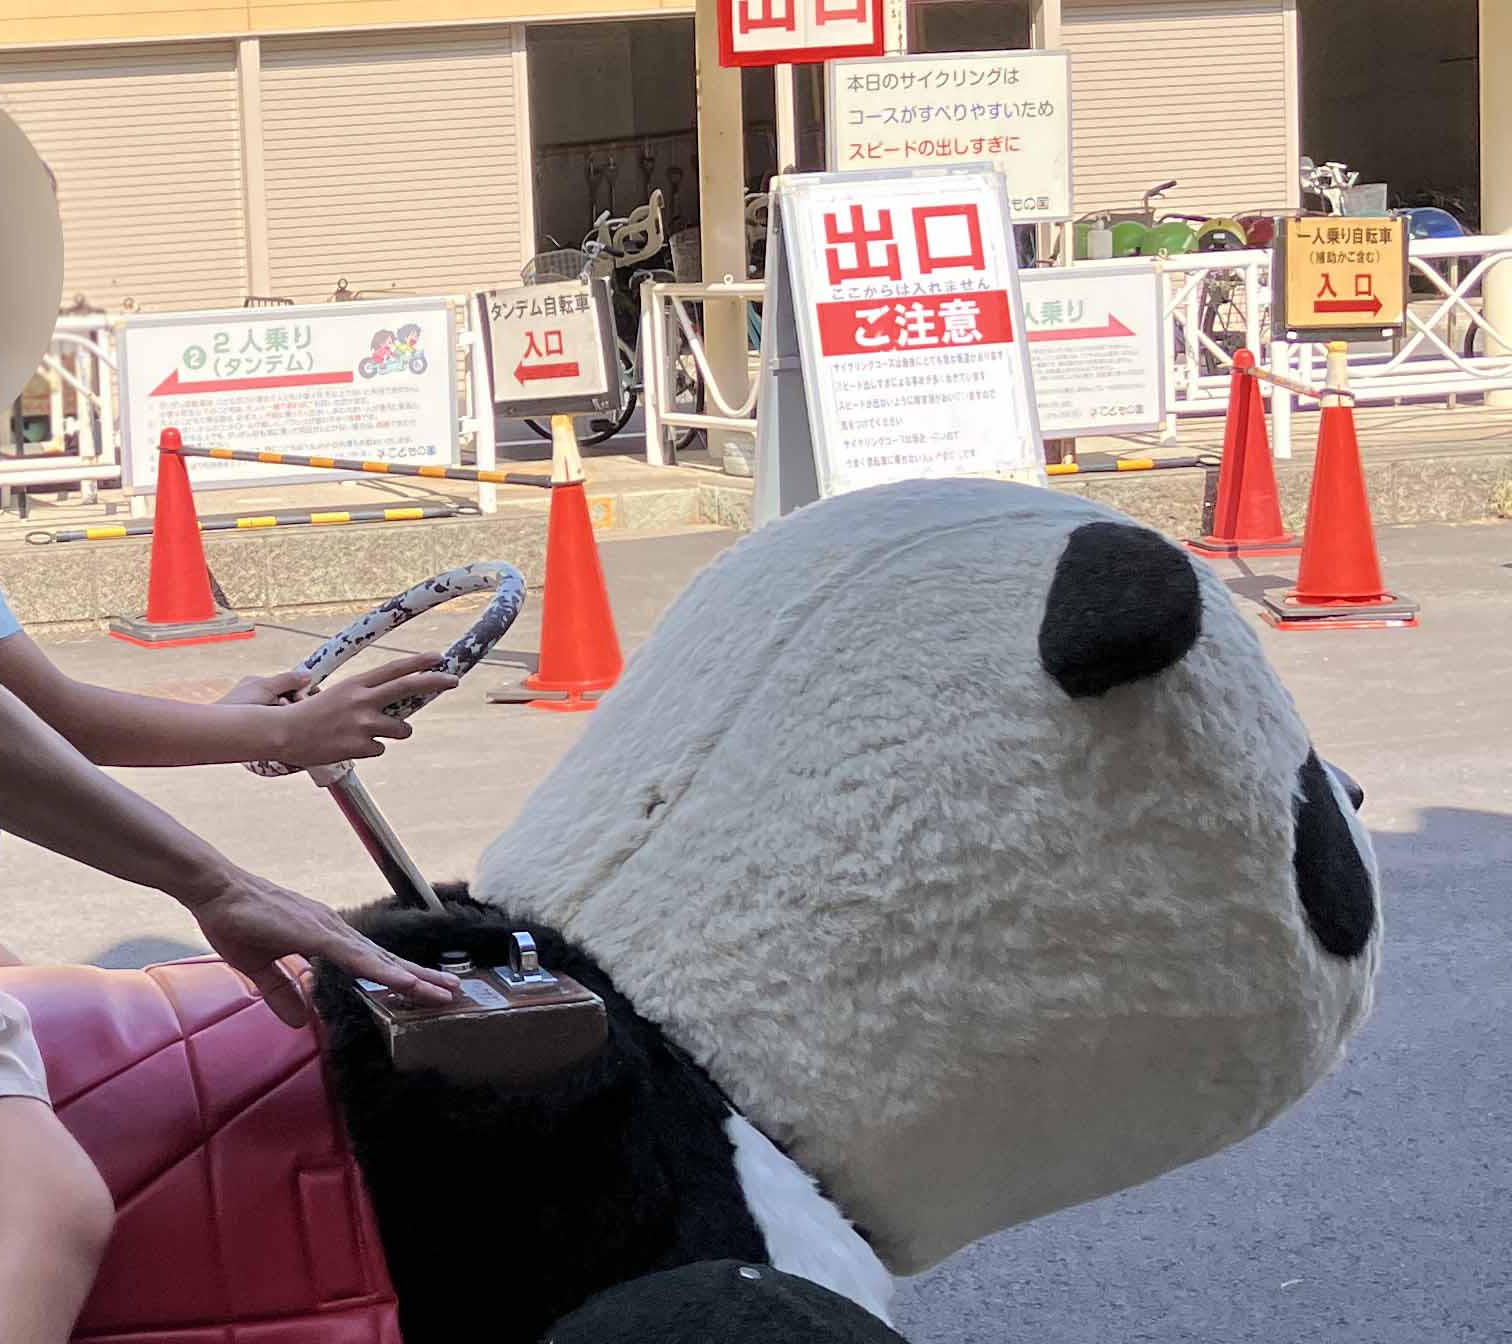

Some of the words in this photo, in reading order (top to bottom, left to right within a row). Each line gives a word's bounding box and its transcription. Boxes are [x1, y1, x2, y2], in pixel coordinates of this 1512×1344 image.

[847, 67, 1020, 93] 本日のサイクリングは
[848, 99, 1055, 126] コースがすべりやすいため
[848, 135, 1022, 161] スピードの出しすぎに
[1008, 196, 1050, 212] もの国
[823, 203, 986, 286] 出口
[1297, 227, 1393, 245] 一人乗り自転車
[831, 276, 990, 301] ここからは入れません
[1316, 272, 1373, 298] 入口
[490, 293, 591, 321] タンデム自転車
[854, 297, 984, 347] ご注意
[524, 329, 564, 359] 入口
[213, 351, 315, 378] (タンデム)
